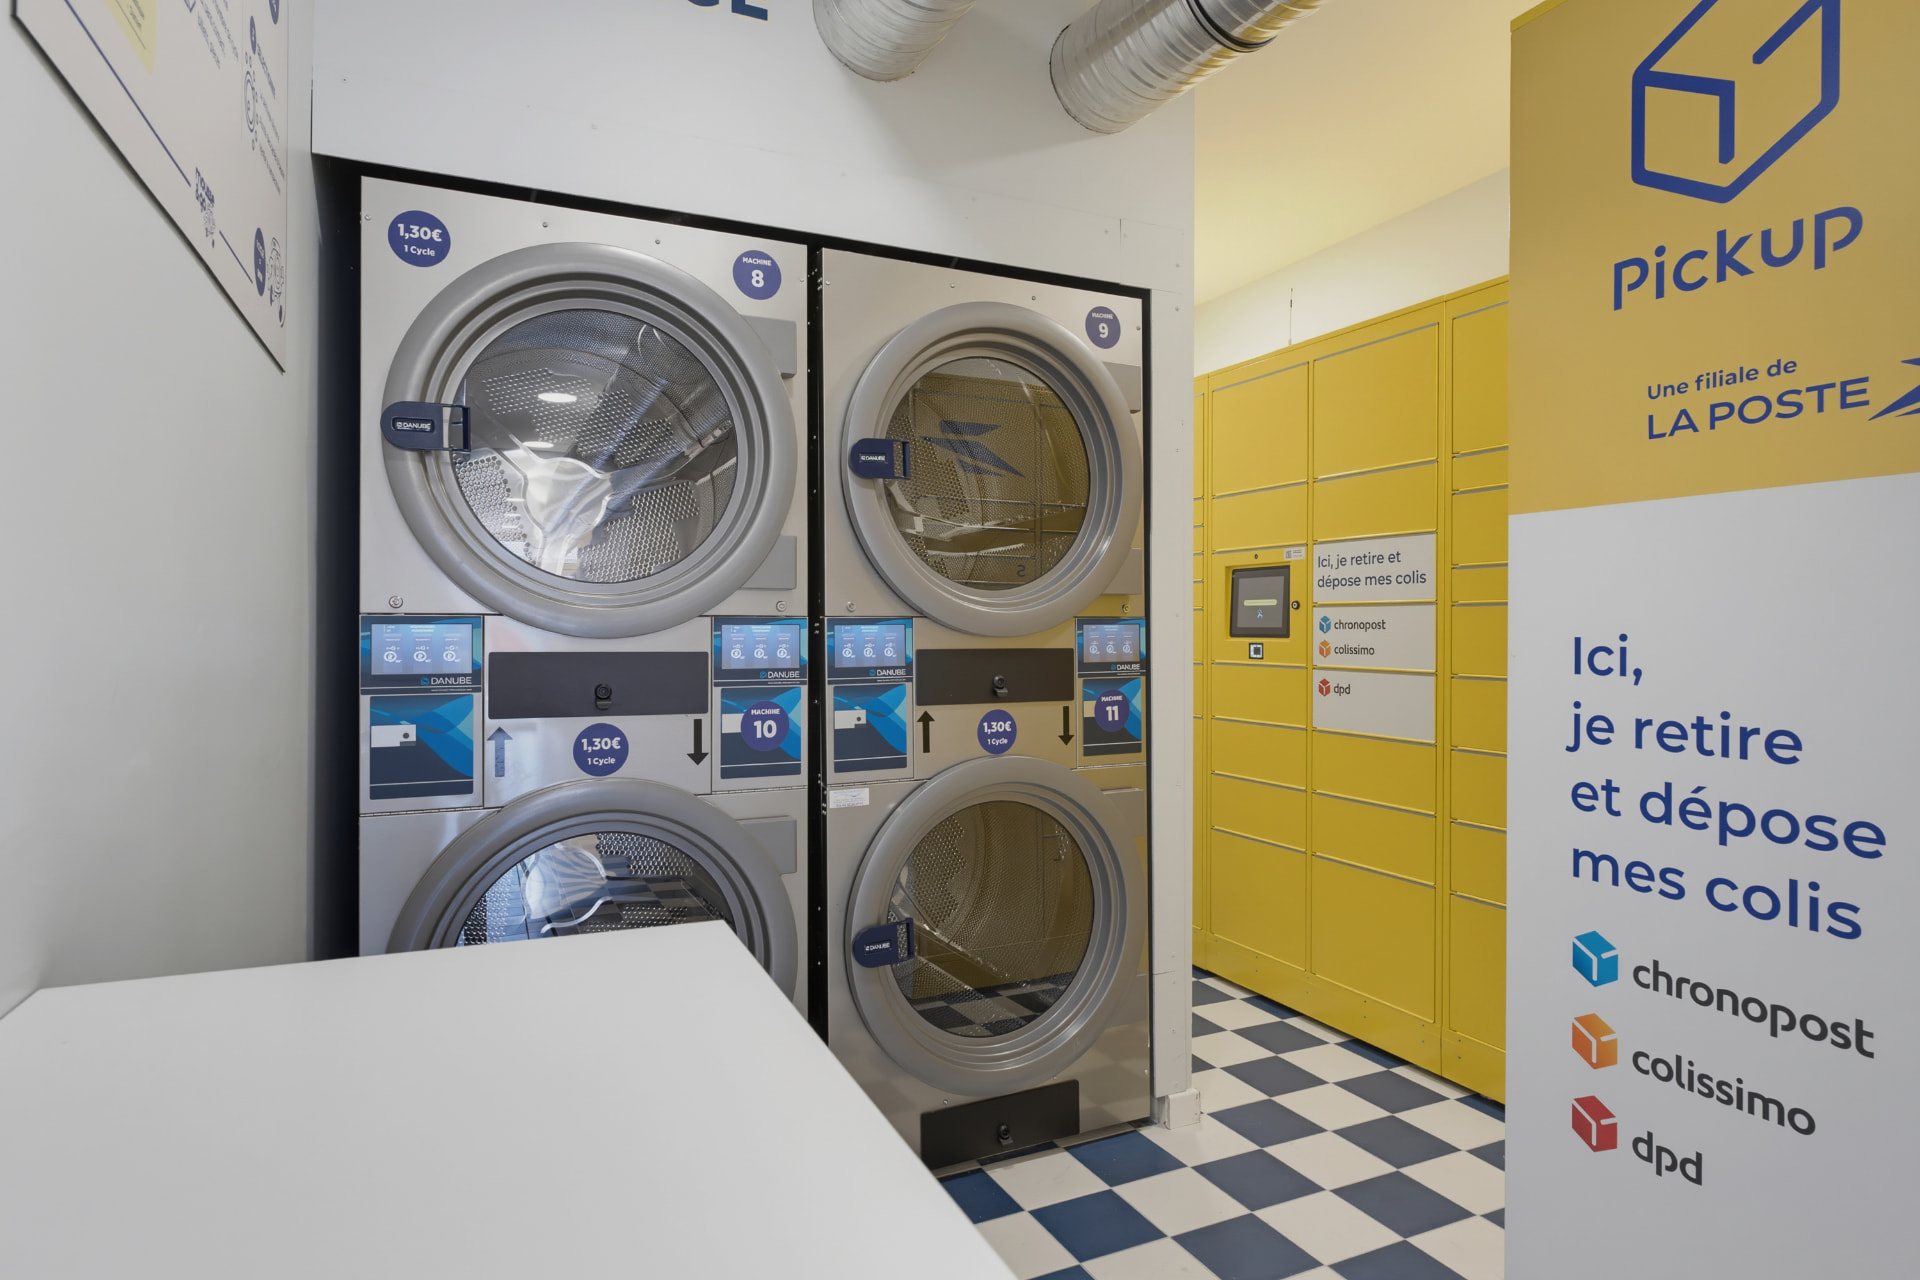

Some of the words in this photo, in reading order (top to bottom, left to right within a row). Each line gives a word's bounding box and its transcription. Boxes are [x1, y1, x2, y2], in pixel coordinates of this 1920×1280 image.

[397, 223, 443, 242] 1,30€
[403, 244, 409, 253] 1
[410, 245, 435, 257] Cycle
[742, 256, 772, 267] MACHINE
[751, 269, 765, 288] 8
[1098, 322, 1109, 339] 9
[1647, 381, 1690, 400] Une
[1694, 366, 1760, 393] filiale
[1766, 358, 1798, 378] de
[1647, 408, 1700, 440] LA
[1708, 376, 1871, 431] POSTE
[1317, 554, 1334, 570] Ici,
[1335, 553, 1348, 570] je
[1350, 551, 1384, 566] retire
[1387, 550, 1402, 564] et
[1317, 574, 1361, 591] dépose
[1364, 574, 1391, 586] mes
[1395, 569, 1427, 585] colis
[1333, 618, 1386, 633] chronopost
[1333, 643, 1375, 656] colissimo
[1116, 663, 1140, 671] DANUBE
[1573, 633, 1643, 686] Ici,
[430, 676, 472, 686] DANUBE
[767, 671, 800, 679] DANUBE
[876, 668, 906, 677] DANUBE
[1333, 682, 1351, 697] dpd
[751, 708, 780, 717] MACHINE
[1106, 705, 1119, 722] 11
[753, 719, 778, 739] 10
[983, 720, 1011, 735] 1,30€
[1565, 700, 1615, 753] je
[1634, 710, 1803, 765] retire
[581, 736, 622, 753] 1,30€
[991, 737, 1007, 746] Cycle
[587, 757, 592, 766] 1
[592, 756, 615, 767] Cycle
[1570, 778, 1622, 817] et
[1639, 781, 1887, 860] dépose
[1572, 848, 1687, 901] mes
[1705, 878, 1863, 940] colis
[1632, 959, 1875, 1059] chronopost
[1632, 1050, 1817, 1136] colissimo
[1632, 1130, 1703, 1187] dpd
